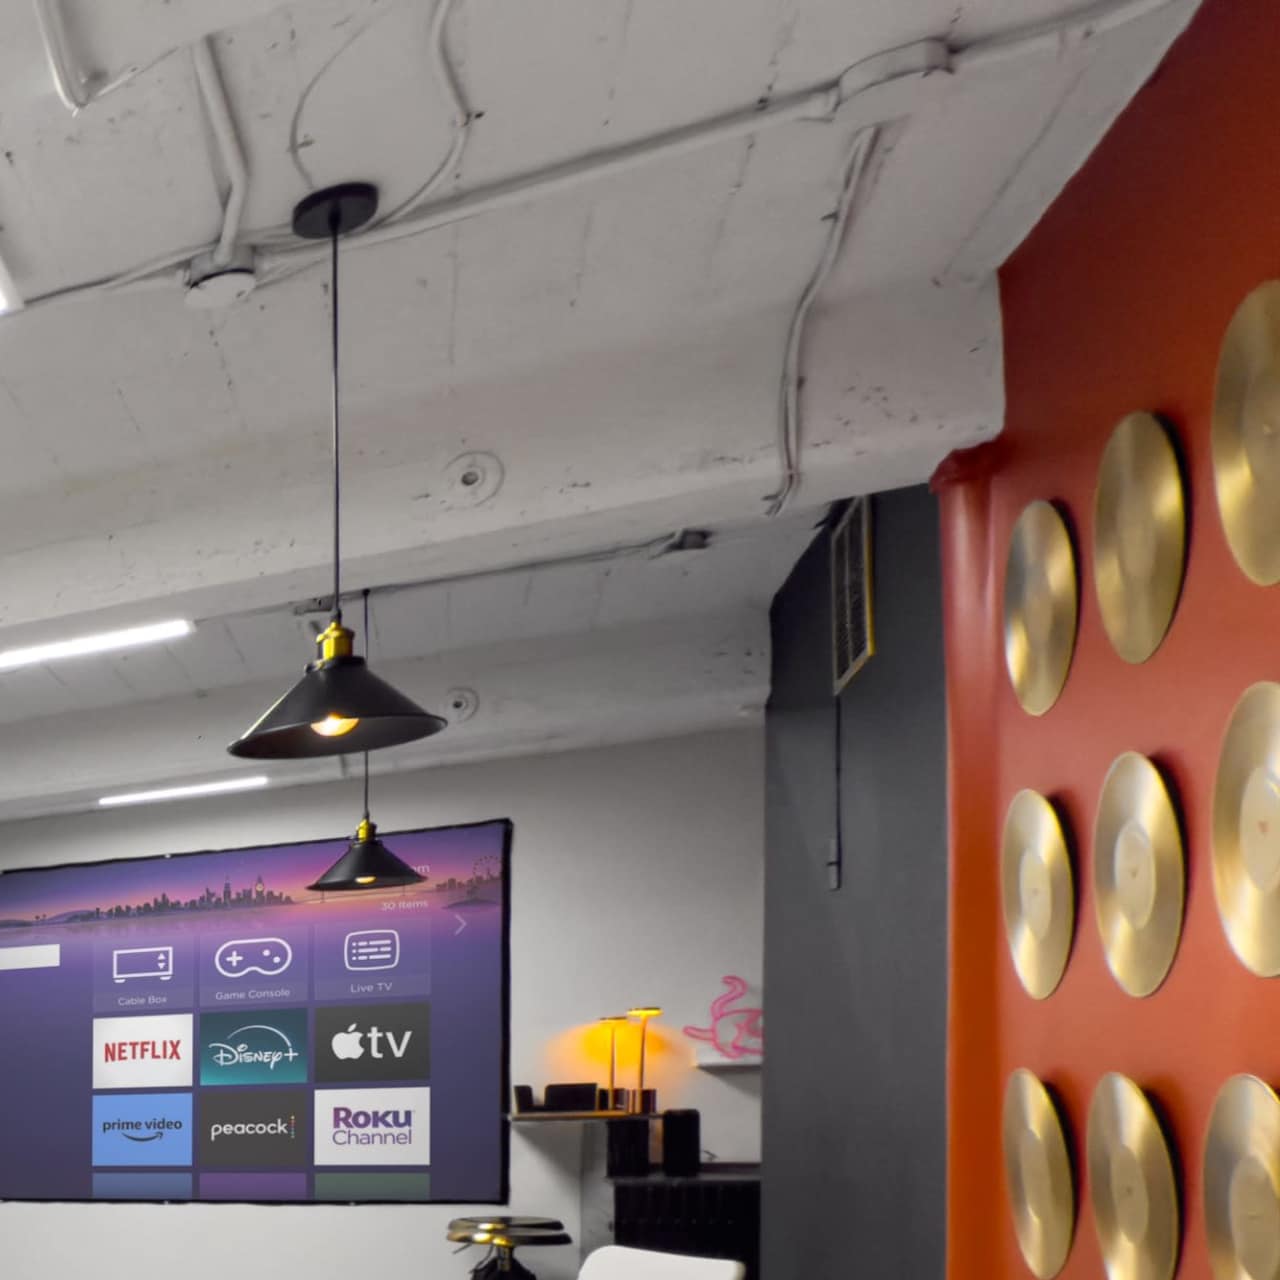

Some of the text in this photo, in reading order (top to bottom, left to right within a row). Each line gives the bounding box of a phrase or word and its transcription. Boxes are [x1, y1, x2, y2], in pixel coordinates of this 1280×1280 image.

[215, 988, 290, 1001] Game Console
[350, 982, 393, 993] Live TV
[117, 995, 167, 1006] Cable Box
[366, 1026, 413, 1059] tv
[104, 1040, 181, 1063] NETFLIX
[102, 1118, 183, 1133] prime video
[210, 1118, 288, 1142] peacock
[332, 1129, 412, 1146] Channel
